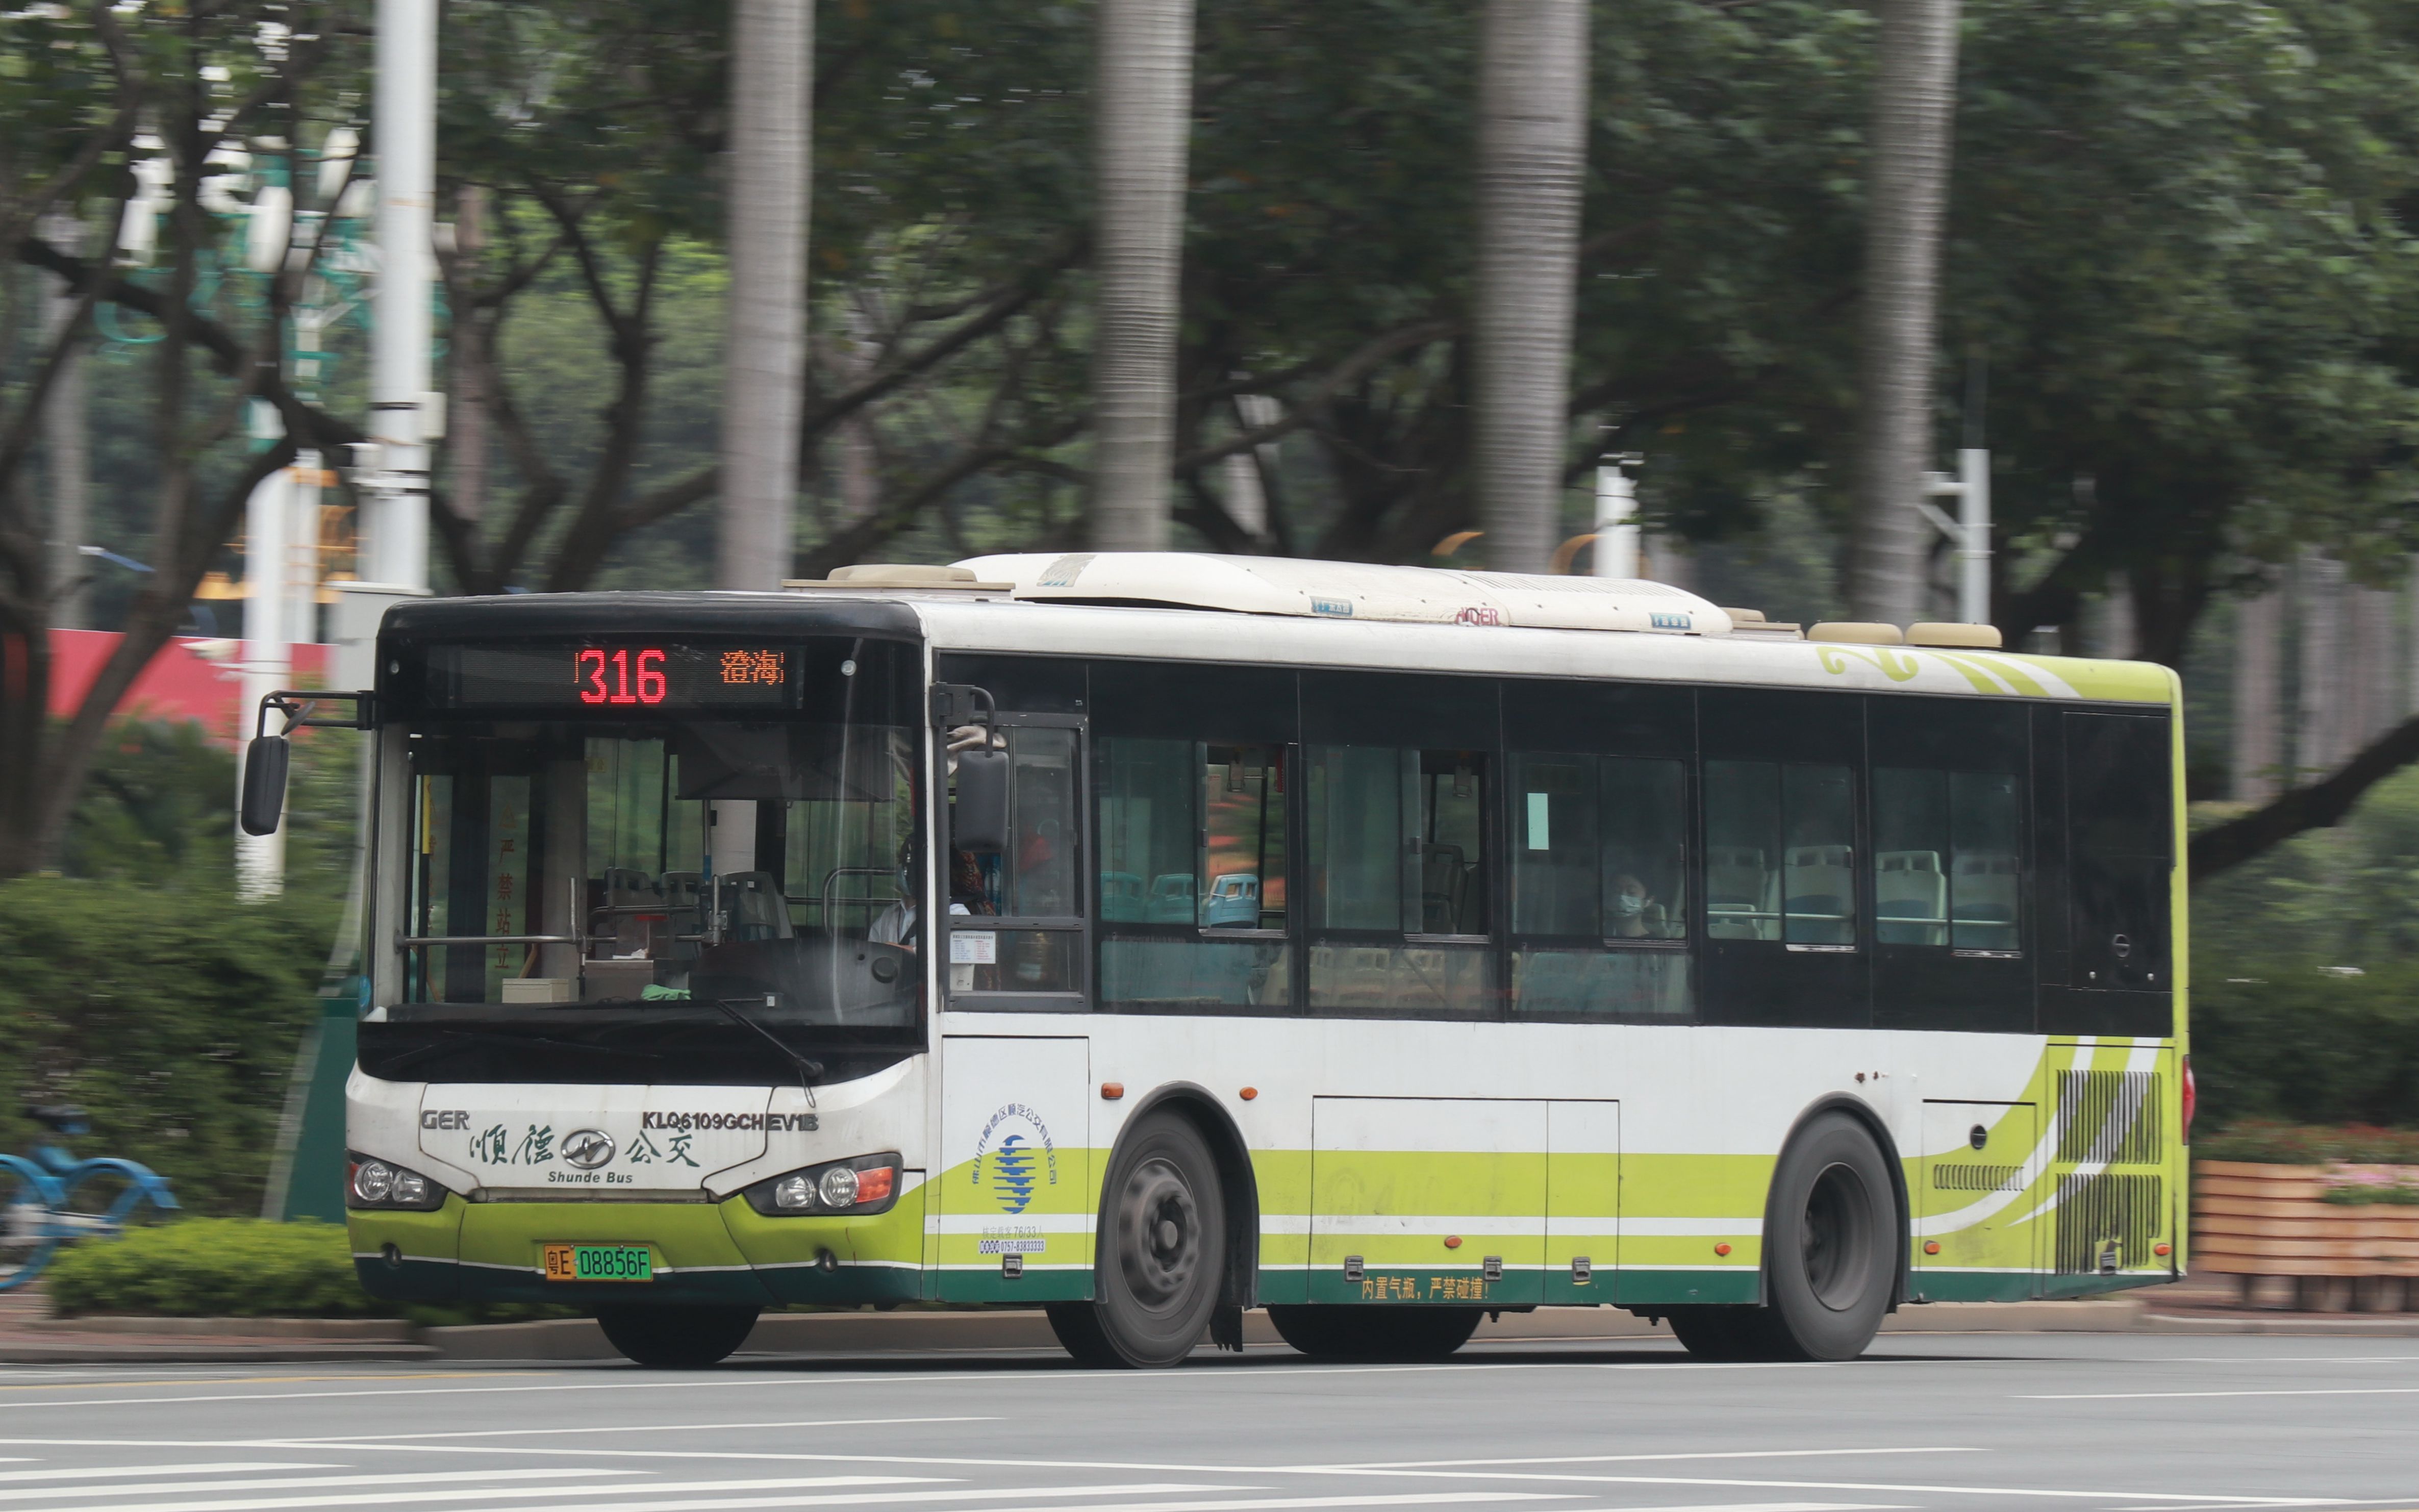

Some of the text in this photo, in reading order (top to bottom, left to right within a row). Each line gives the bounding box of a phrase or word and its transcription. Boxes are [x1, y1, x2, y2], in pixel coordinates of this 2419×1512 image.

[579, 649, 666, 703] 316
[720, 649, 785, 685] 澄海
[494, 838, 515, 969] 严禁站立
[421, 1110, 470, 1130] GER
[642, 1111, 819, 1131] KLQ6109GCHEV1B
[548, 1171, 633, 1183] Shunde Bus
